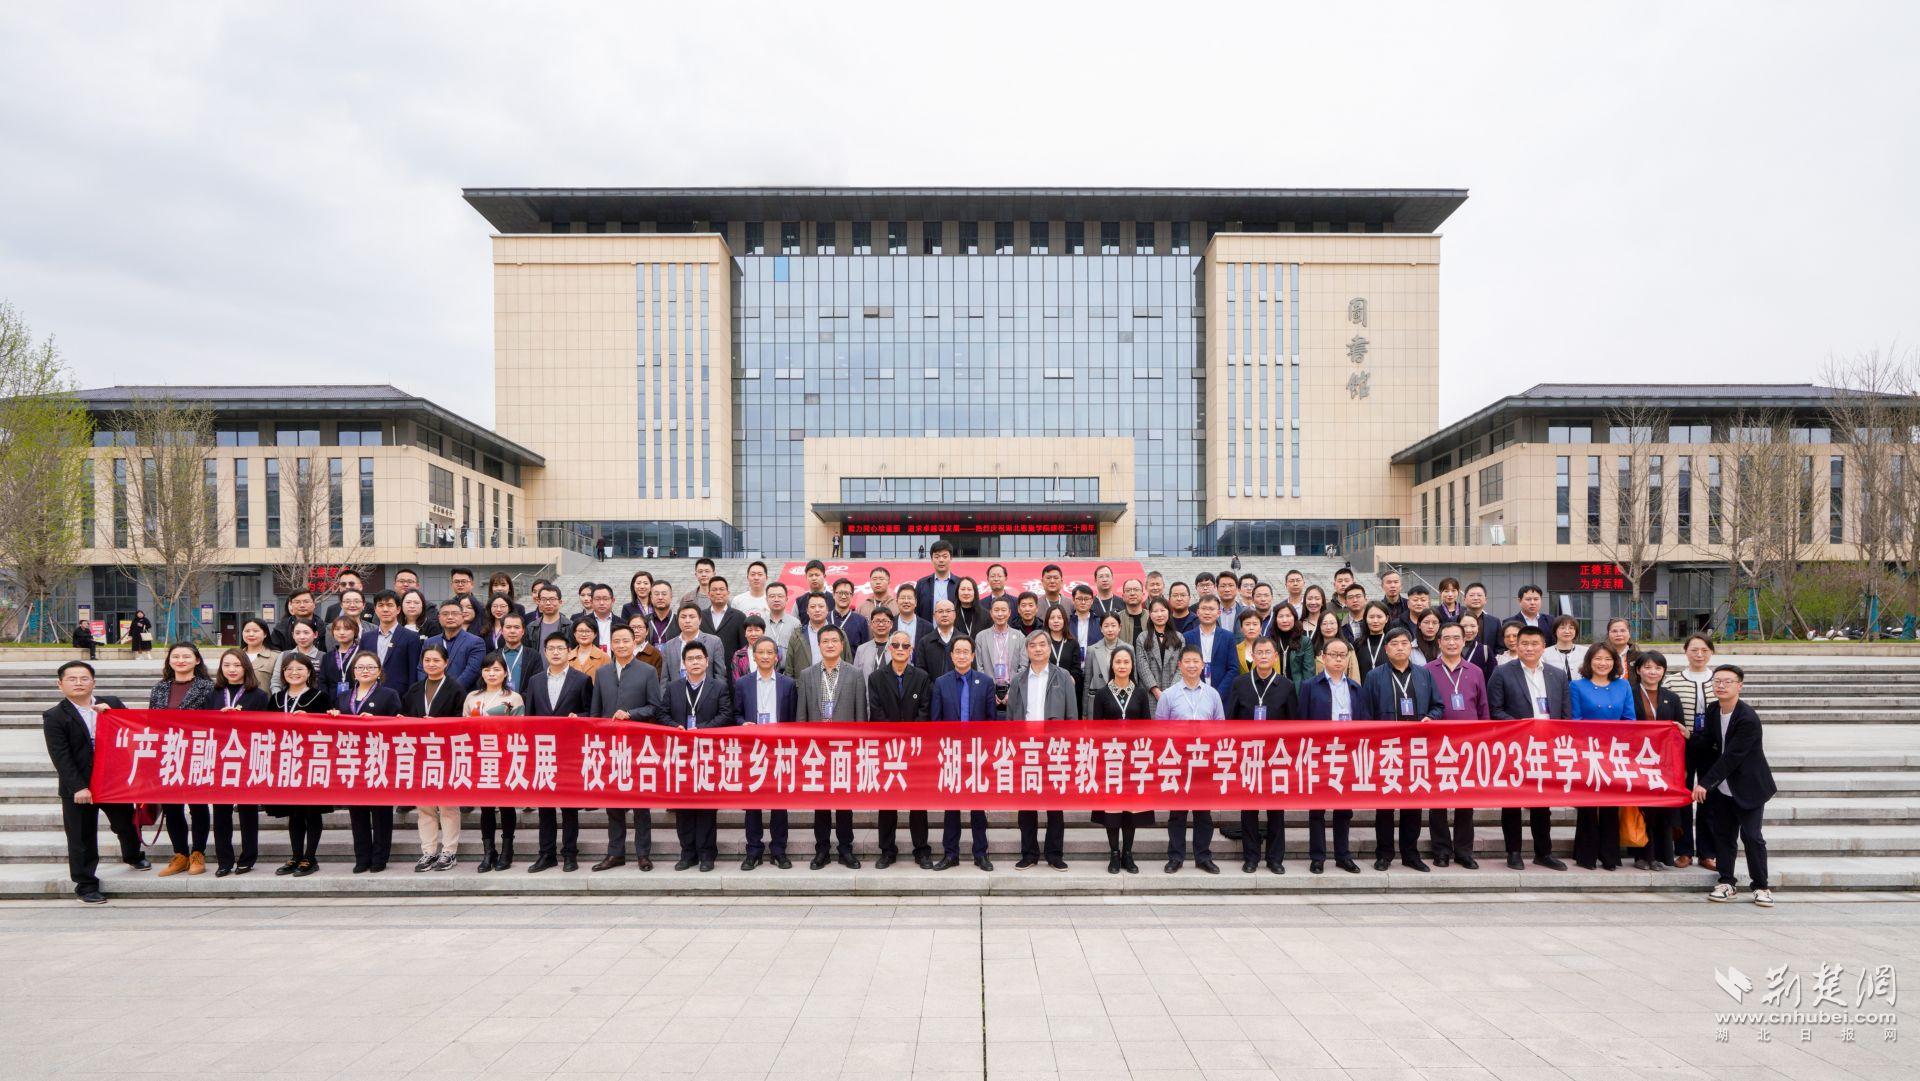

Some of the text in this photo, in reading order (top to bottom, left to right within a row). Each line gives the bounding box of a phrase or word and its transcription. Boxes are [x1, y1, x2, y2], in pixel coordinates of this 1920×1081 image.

[116, 727, 1669, 794] “产教融合赋能高等教育高质量发展 校地合作促进乡村全面振兴” 湖北省高等教育学会产学研合作专业委员会2023年学术年会
